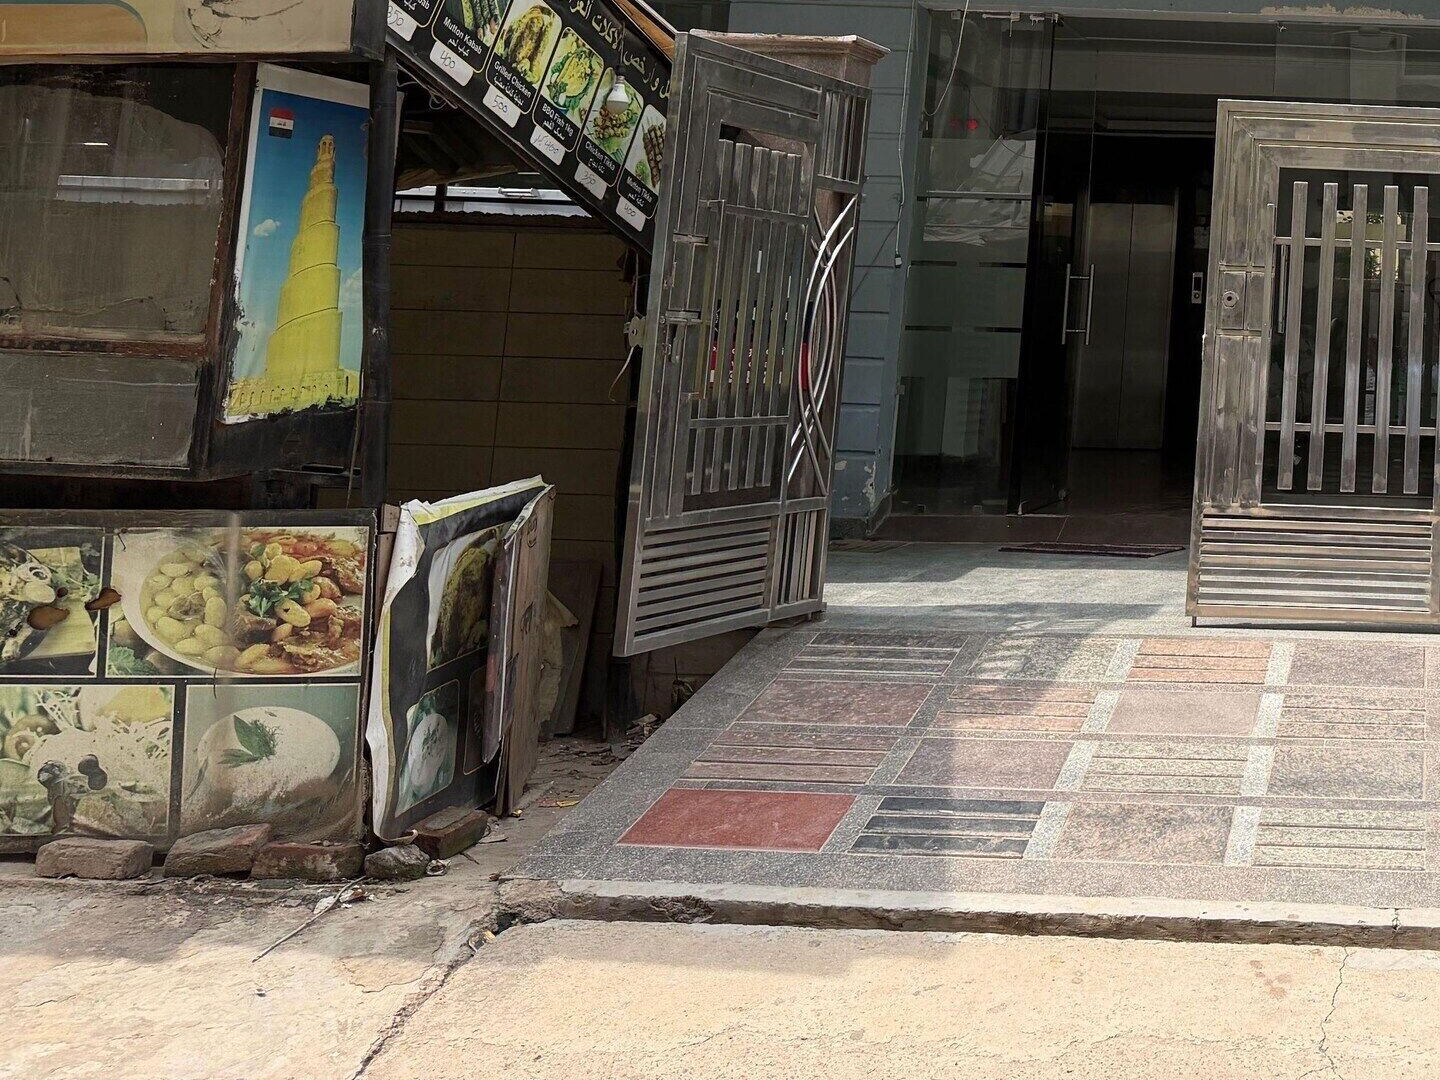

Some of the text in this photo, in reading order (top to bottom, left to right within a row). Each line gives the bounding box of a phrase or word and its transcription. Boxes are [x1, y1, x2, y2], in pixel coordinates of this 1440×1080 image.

[443, 17, 482, 55] Mutton Kabab
[494, 60, 531, 98] Grilled Chicken
[542, 103, 555, 118] BBQ
[554, 113, 565, 128] Fish
[585, 141, 615, 171] Chicken Tikka
[626, 176, 653, 202] Mutton Tikka
